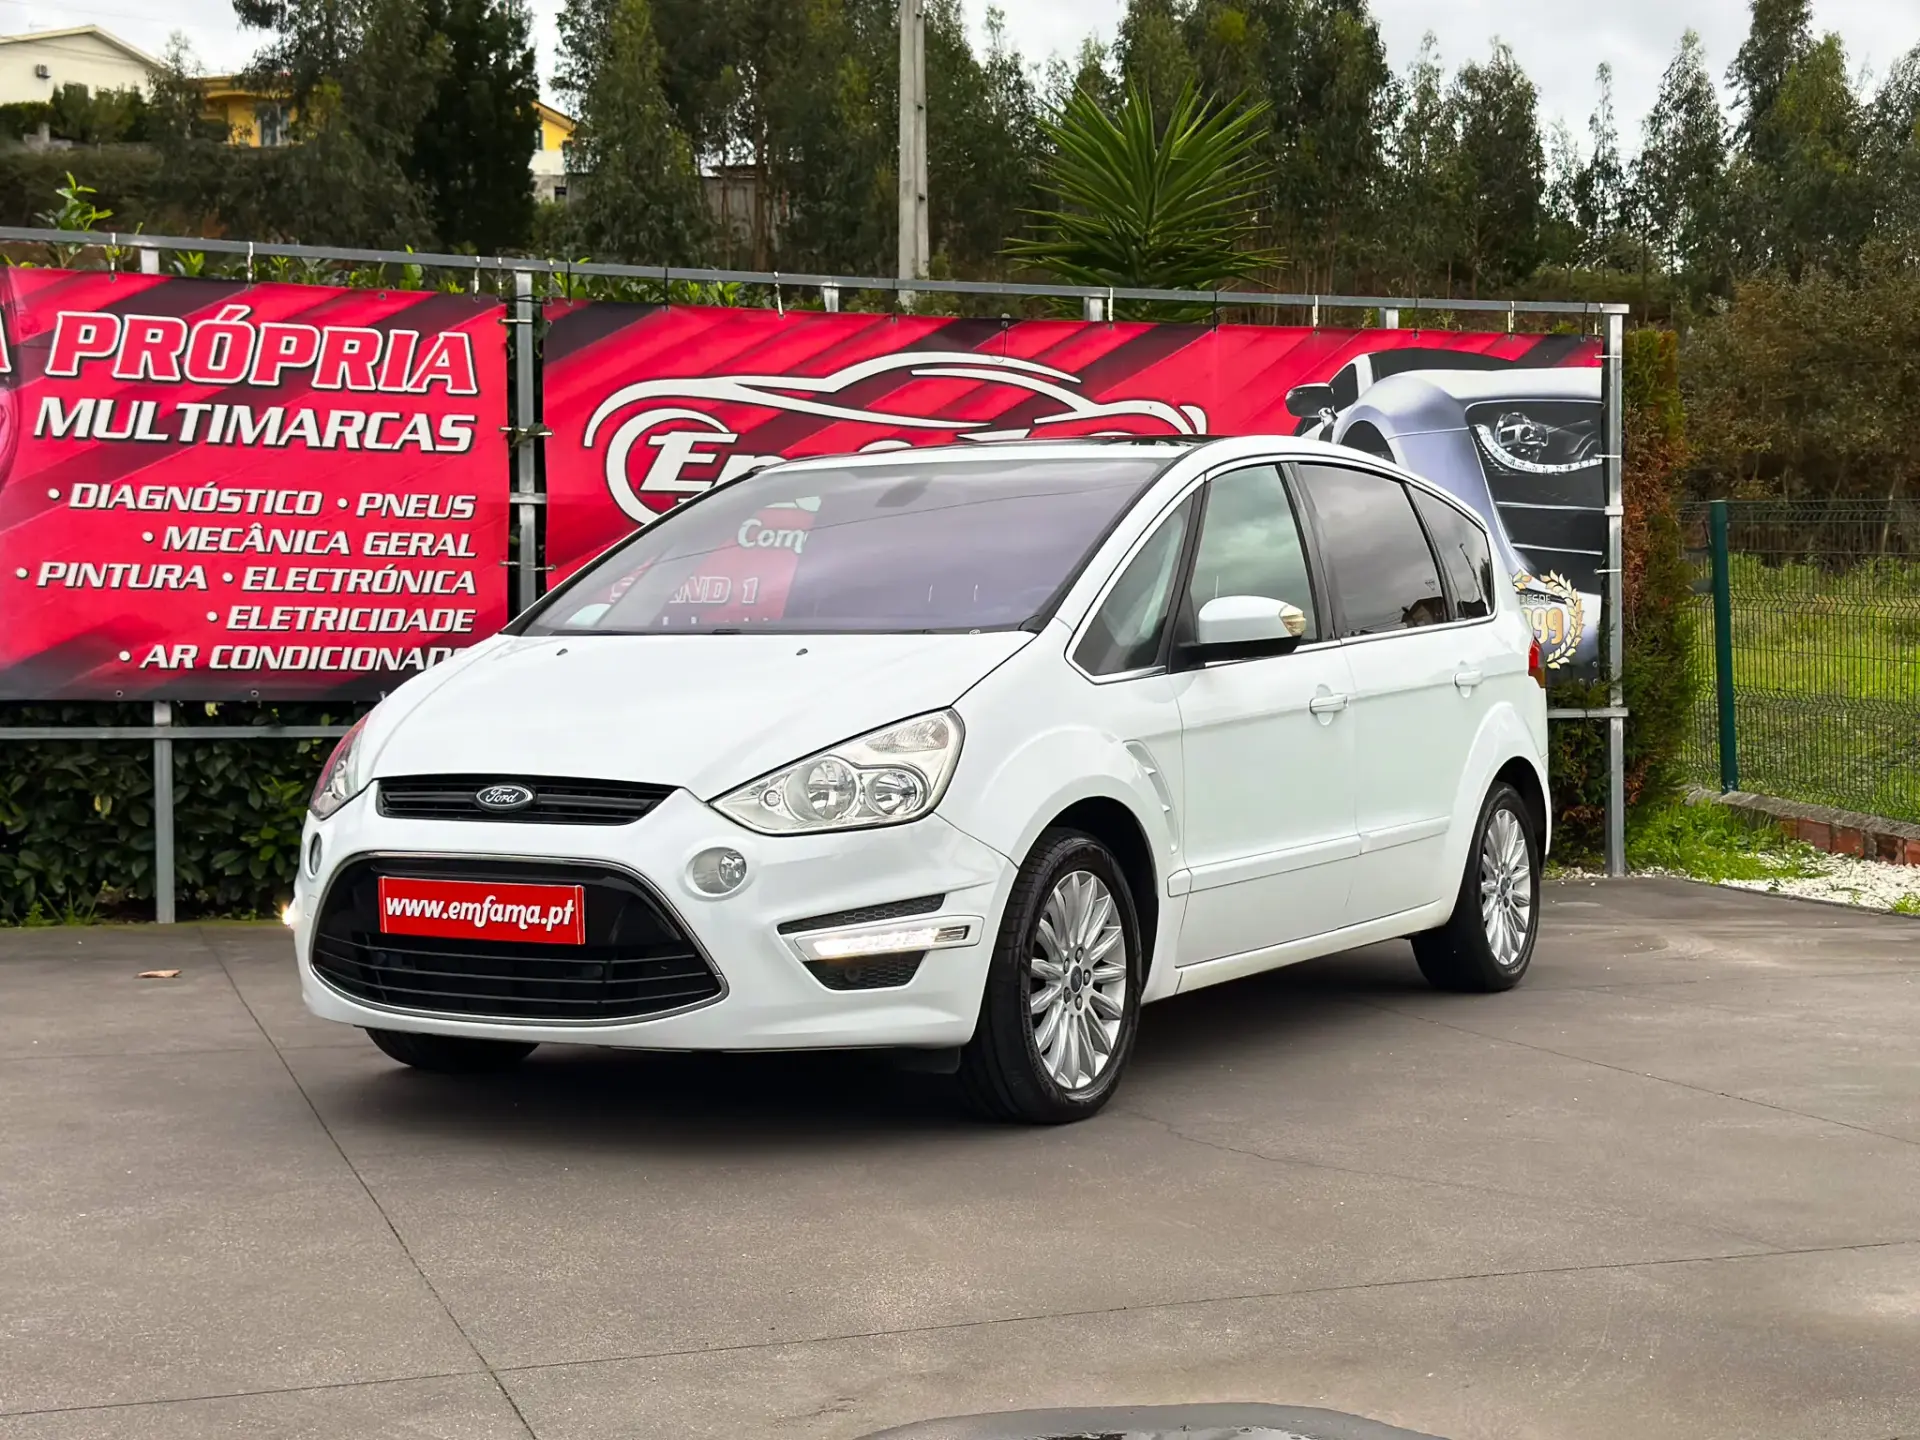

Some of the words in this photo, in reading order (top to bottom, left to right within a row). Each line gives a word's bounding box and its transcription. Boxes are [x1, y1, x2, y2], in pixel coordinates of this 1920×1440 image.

[45, 304, 478, 394] PRÓPRIA
[34, 396, 476, 453] MULTIMARCAS
[69, 482, 323, 515] DIAGNÓSTICO
[356, 492, 476, 519] PNEUS
[162, 522, 350, 555] MECÂNICA
[363, 531, 477, 558] GERAL
[36, 561, 207, 590] PINTURA
[242, 564, 476, 595] ELECTRÓNICA
[226, 605, 476, 633] ELETRICIDADE
[139, 644, 198, 669] AR
[209, 644, 466, 671] CONDICIONAD
[484, 787, 519, 804] Ford
[386, 894, 575, 932] www.emfama.pt
